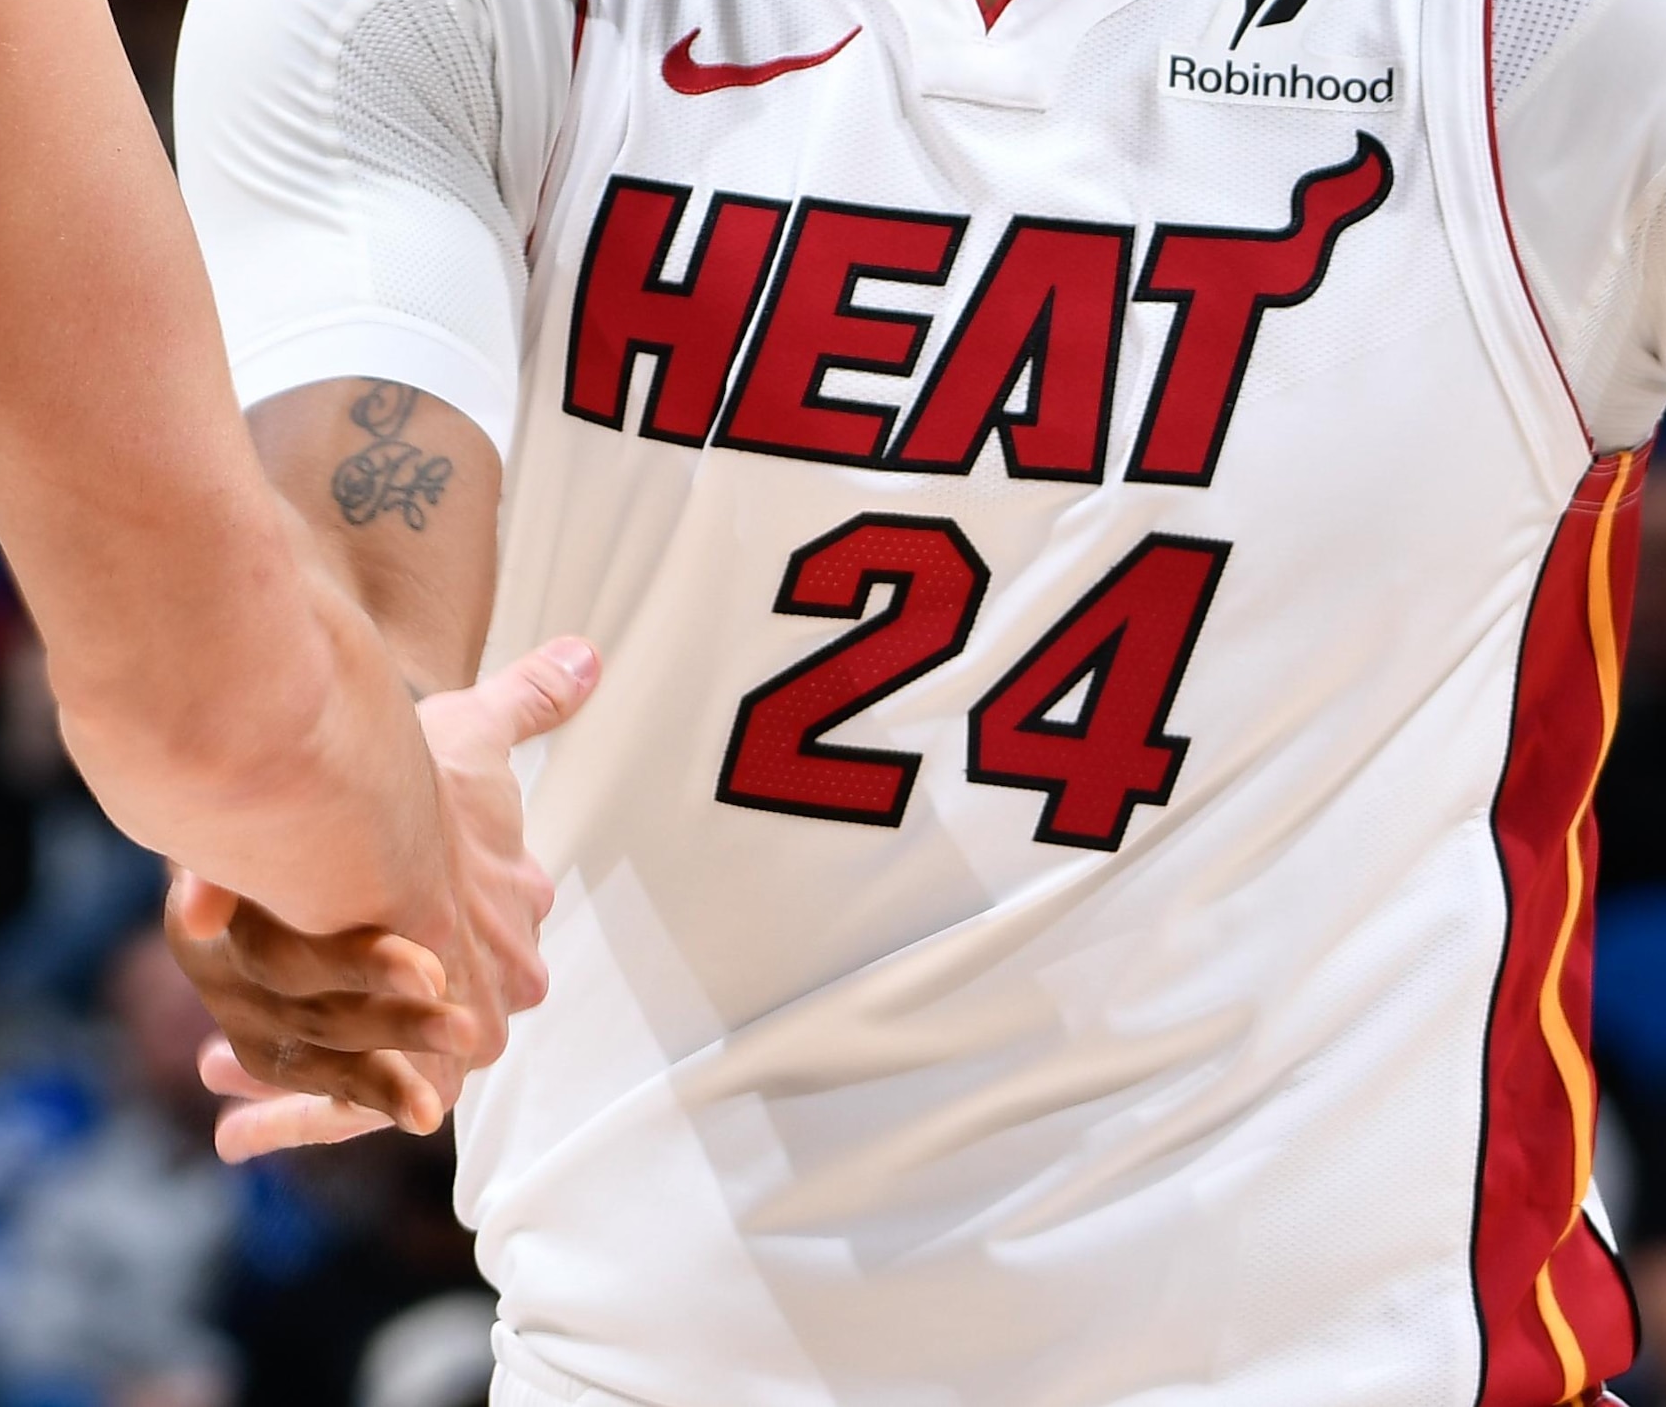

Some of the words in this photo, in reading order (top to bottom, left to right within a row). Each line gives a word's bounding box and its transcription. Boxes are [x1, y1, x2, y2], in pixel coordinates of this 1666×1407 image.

[1168, 54, 1394, 103] Robinhood
[563, 128, 1395, 488] HEAT
[715, 511, 1234, 852] 24
